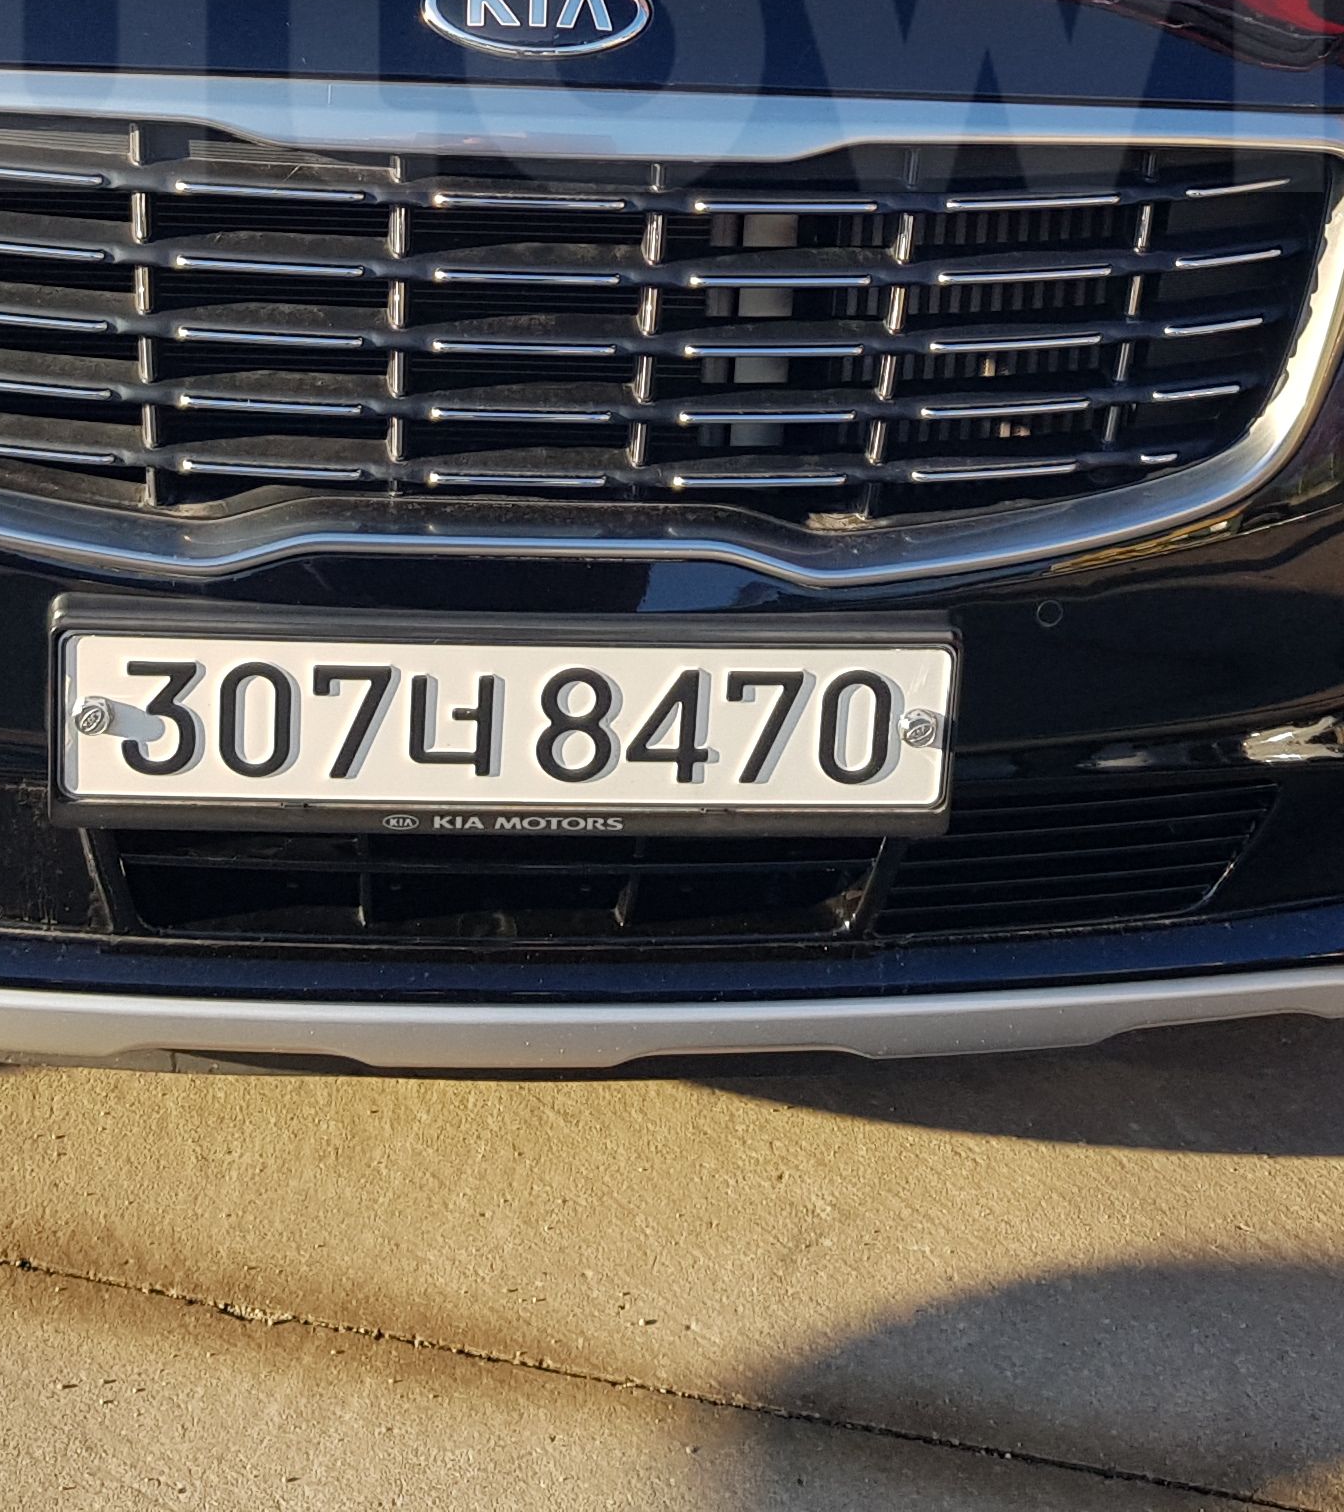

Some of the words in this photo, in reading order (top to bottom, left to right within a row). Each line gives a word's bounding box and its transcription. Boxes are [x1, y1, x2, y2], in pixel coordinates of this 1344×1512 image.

[121, 661, 496, 779] 307너
[535, 666, 893, 785] 8470
[433, 815, 485, 830] KIA
[494, 816, 624, 831] MOTORS
